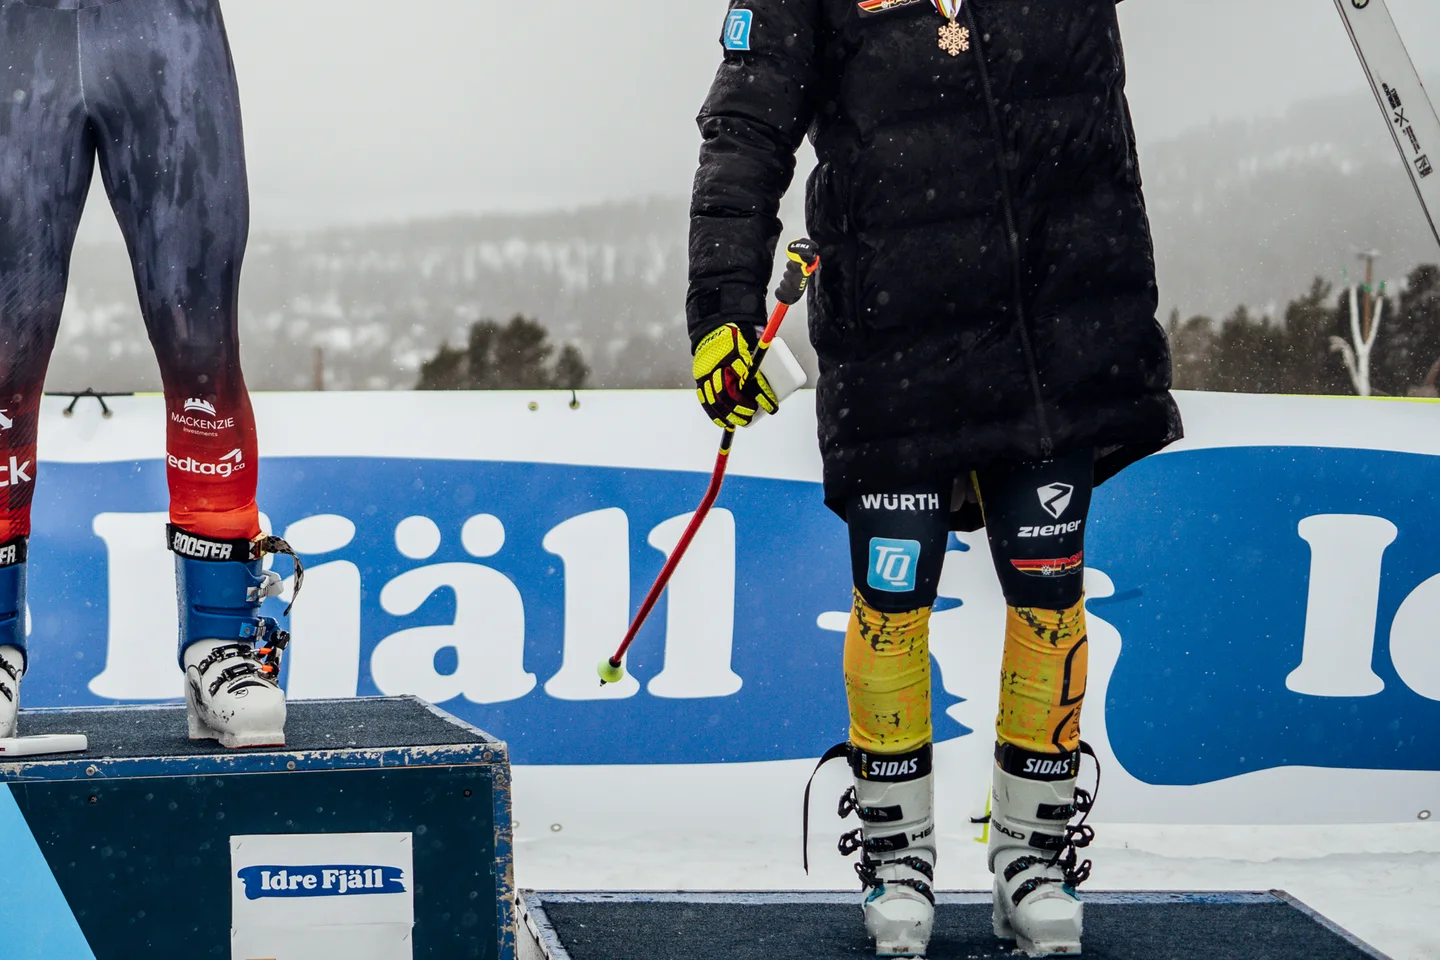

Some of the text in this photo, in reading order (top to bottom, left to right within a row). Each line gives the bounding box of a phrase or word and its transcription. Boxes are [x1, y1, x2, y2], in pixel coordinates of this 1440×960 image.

[790, 242, 810, 250] LEKI
[170, 411, 235, 430] MACKENZIE
[861, 492, 940, 511] WÜRTH
[1017, 518, 1082, 538] ziener
[173, 531, 233, 560] BOOSTER
[875, 545, 911, 587] TQ
[869, 757, 918, 776] SIDAS
[1022, 757, 1071, 775] SIDAS
[260, 868, 384, 894] Idre Fjäll
